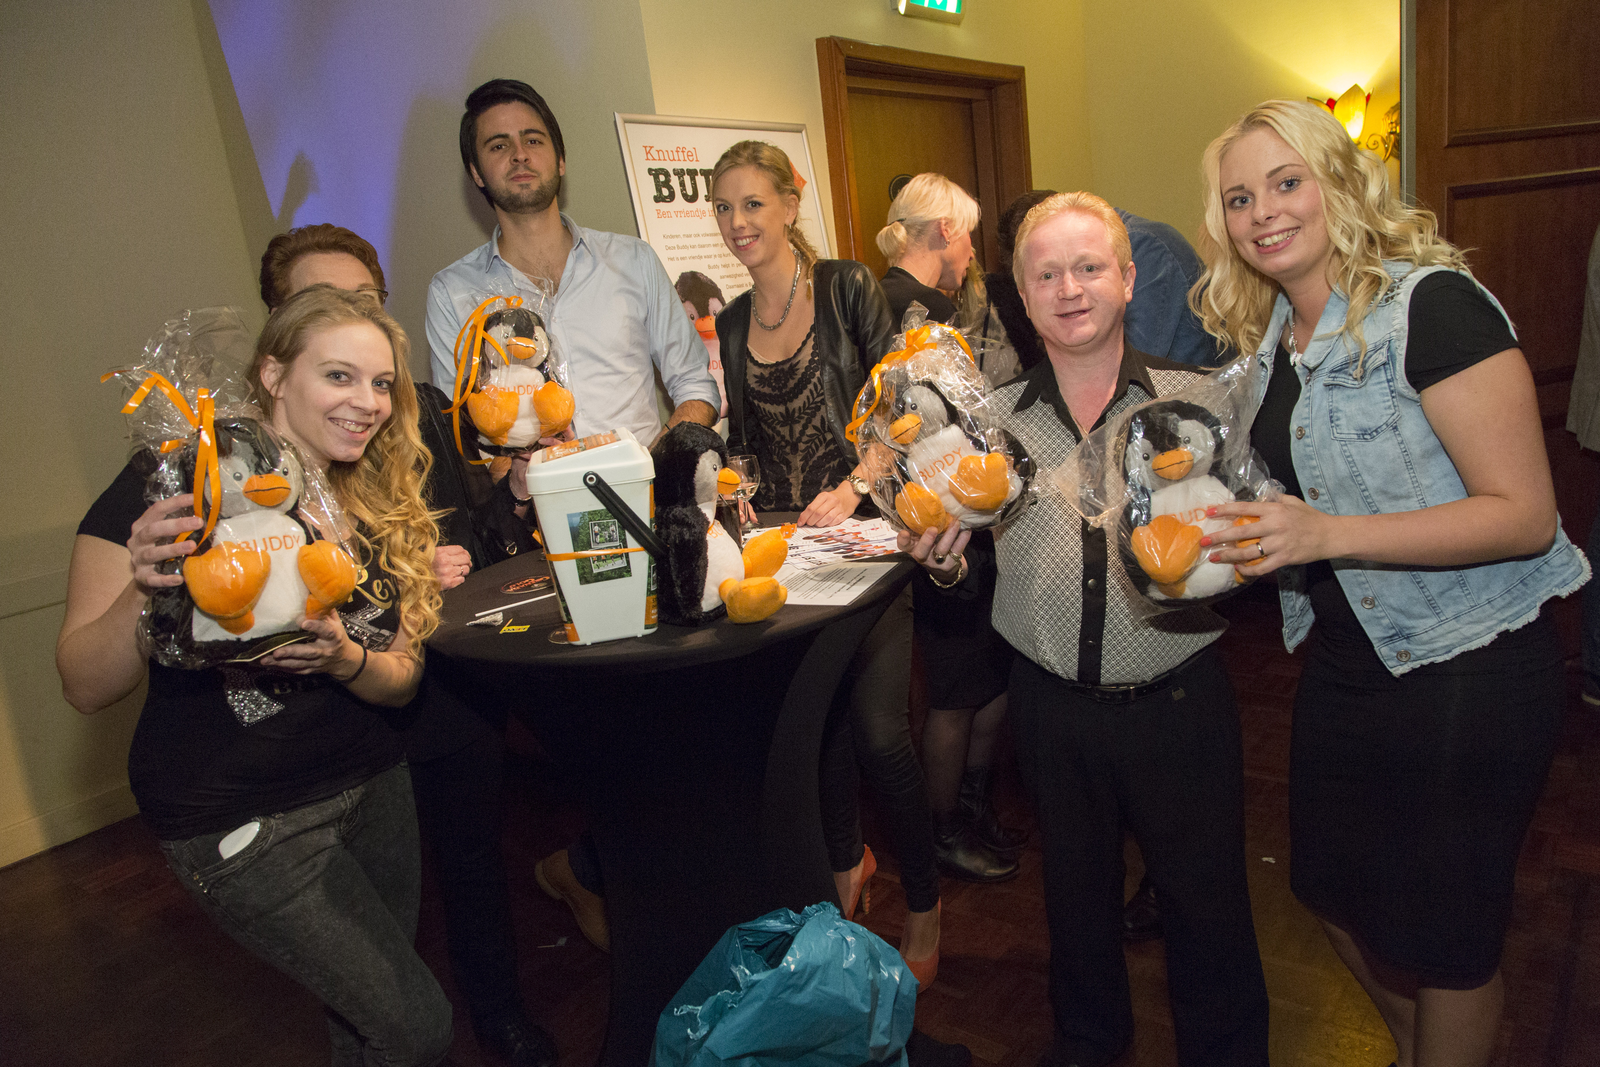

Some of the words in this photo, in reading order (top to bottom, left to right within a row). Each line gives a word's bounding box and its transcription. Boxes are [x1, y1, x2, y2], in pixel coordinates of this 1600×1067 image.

[642, 145, 700, 162] Knuffel
[655, 208, 672, 219] Een
[674, 207, 707, 219] vriendje
[917, 446, 963, 483] BUDDY
[238, 534, 301, 552] BUDDY
